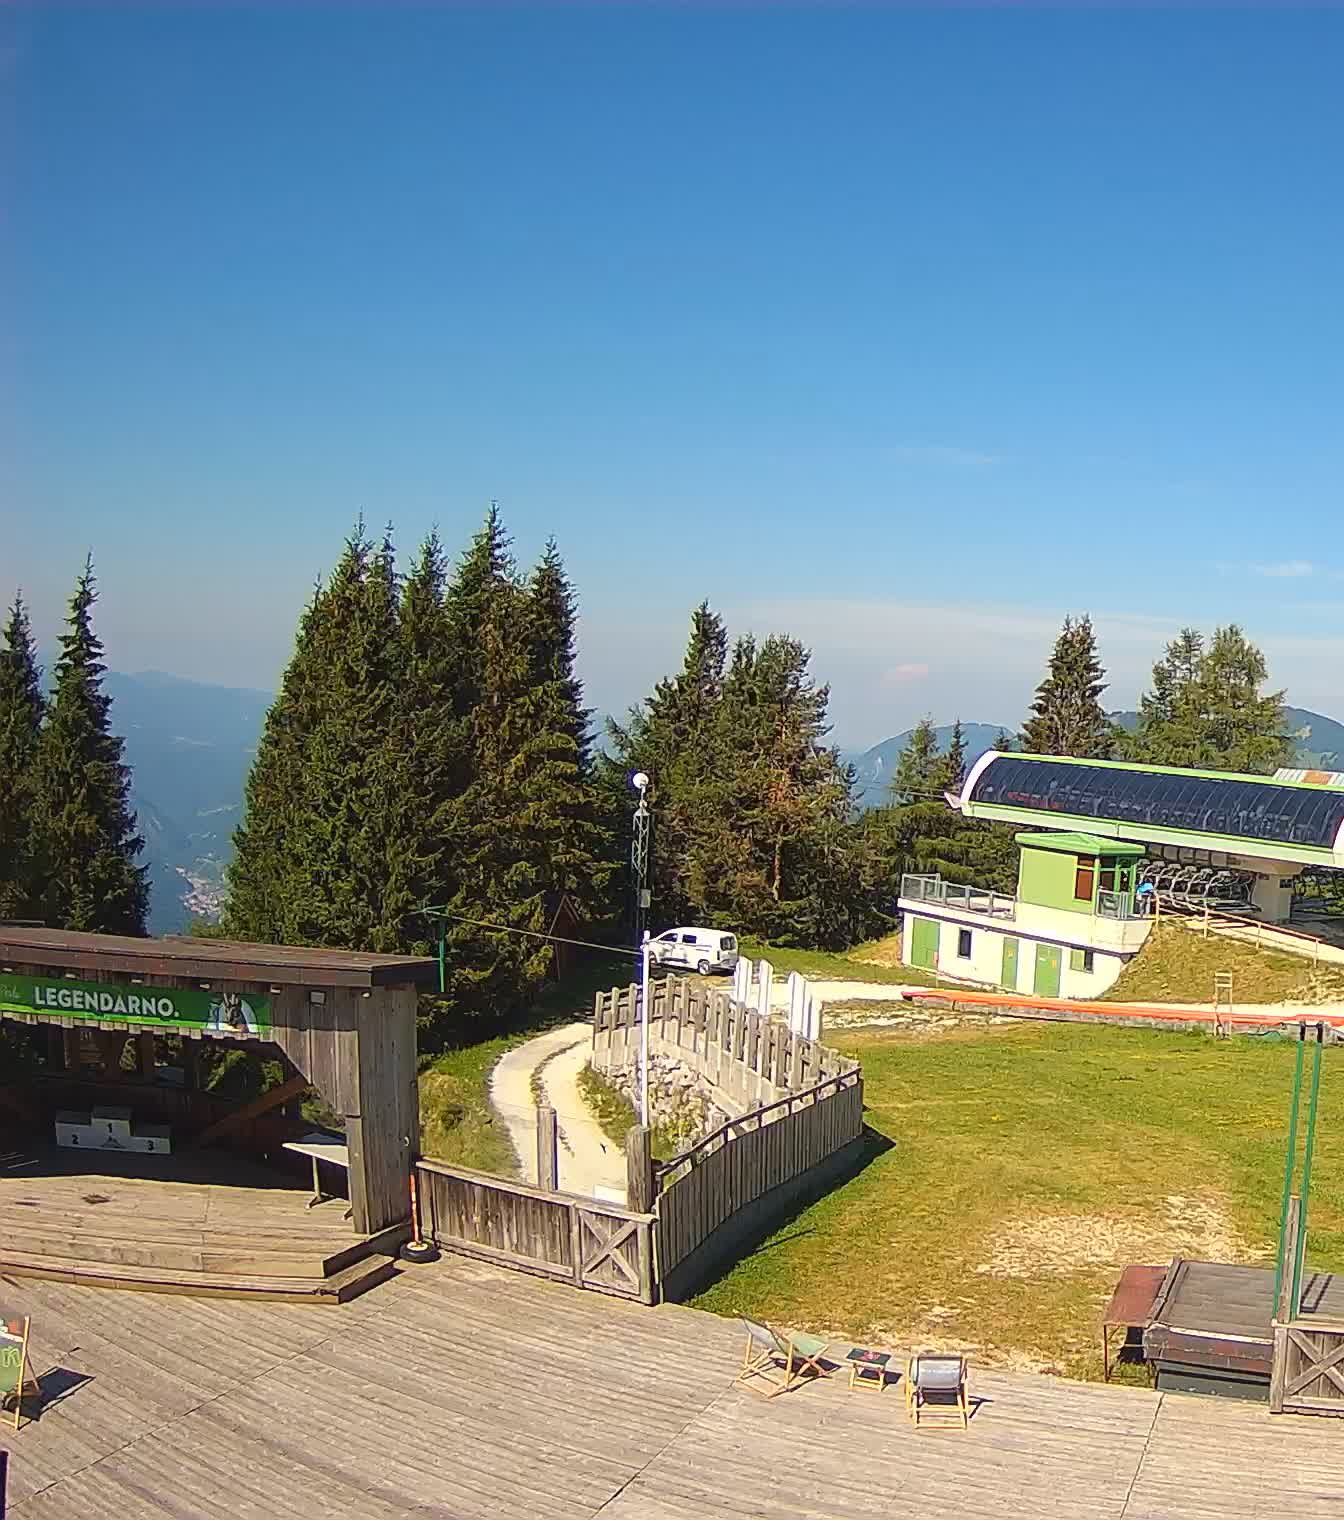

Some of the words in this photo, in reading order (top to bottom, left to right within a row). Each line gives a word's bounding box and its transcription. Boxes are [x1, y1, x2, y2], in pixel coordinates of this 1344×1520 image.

[34, 986, 180, 1017] LEGENDARNO.
[107, 1123, 113, 1133] 1
[71, 1134, 79, 1145] 2
[147, 1140, 155, 1151] 3
